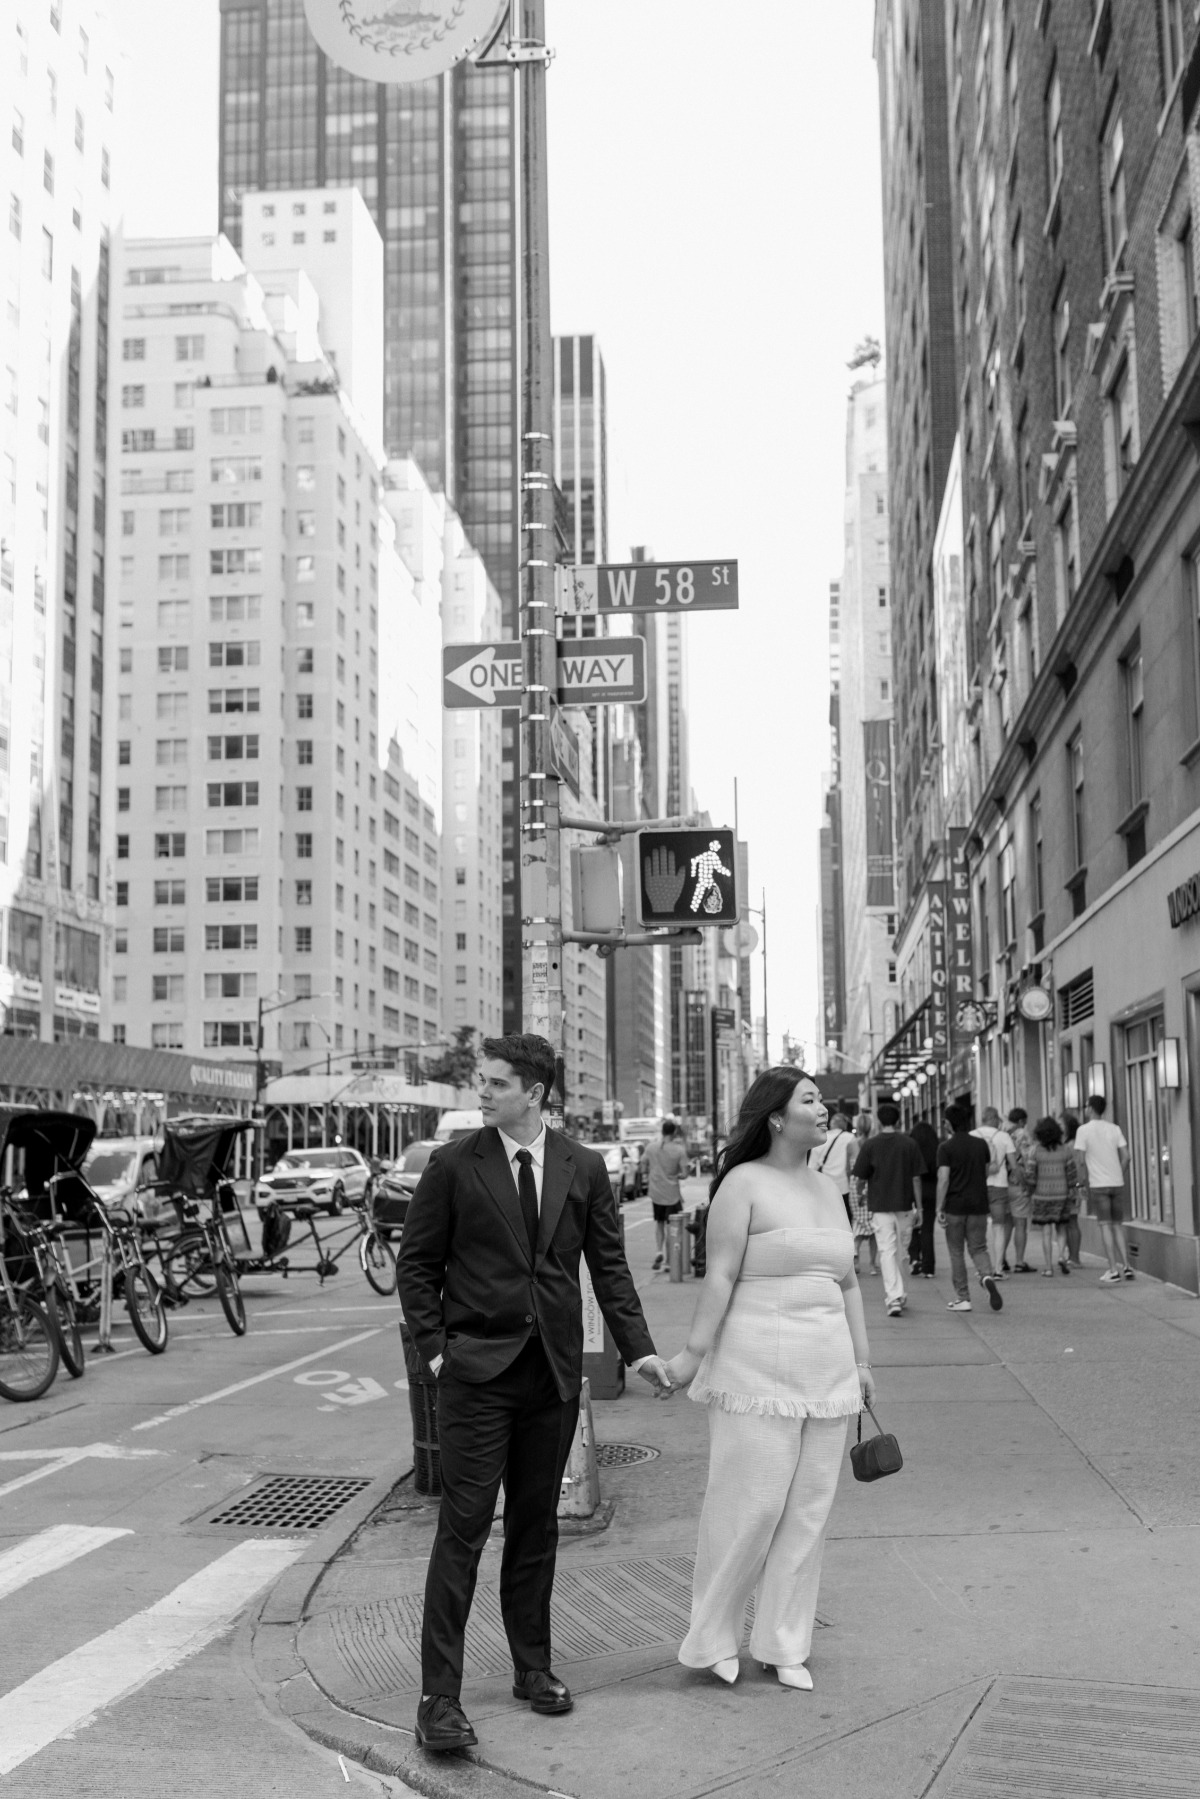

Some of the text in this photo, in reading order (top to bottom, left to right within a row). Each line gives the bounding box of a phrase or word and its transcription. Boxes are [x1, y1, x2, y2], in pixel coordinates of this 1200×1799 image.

[607, 569, 637, 607] W
[655, 567, 695, 605] 58
[469, 657, 626, 688] ONE WAY
[952, 846, 973, 994] JEWELR
[930, 893, 946, 1046] ANTIQUES
[587, 1296, 595, 1336] WINDOW
